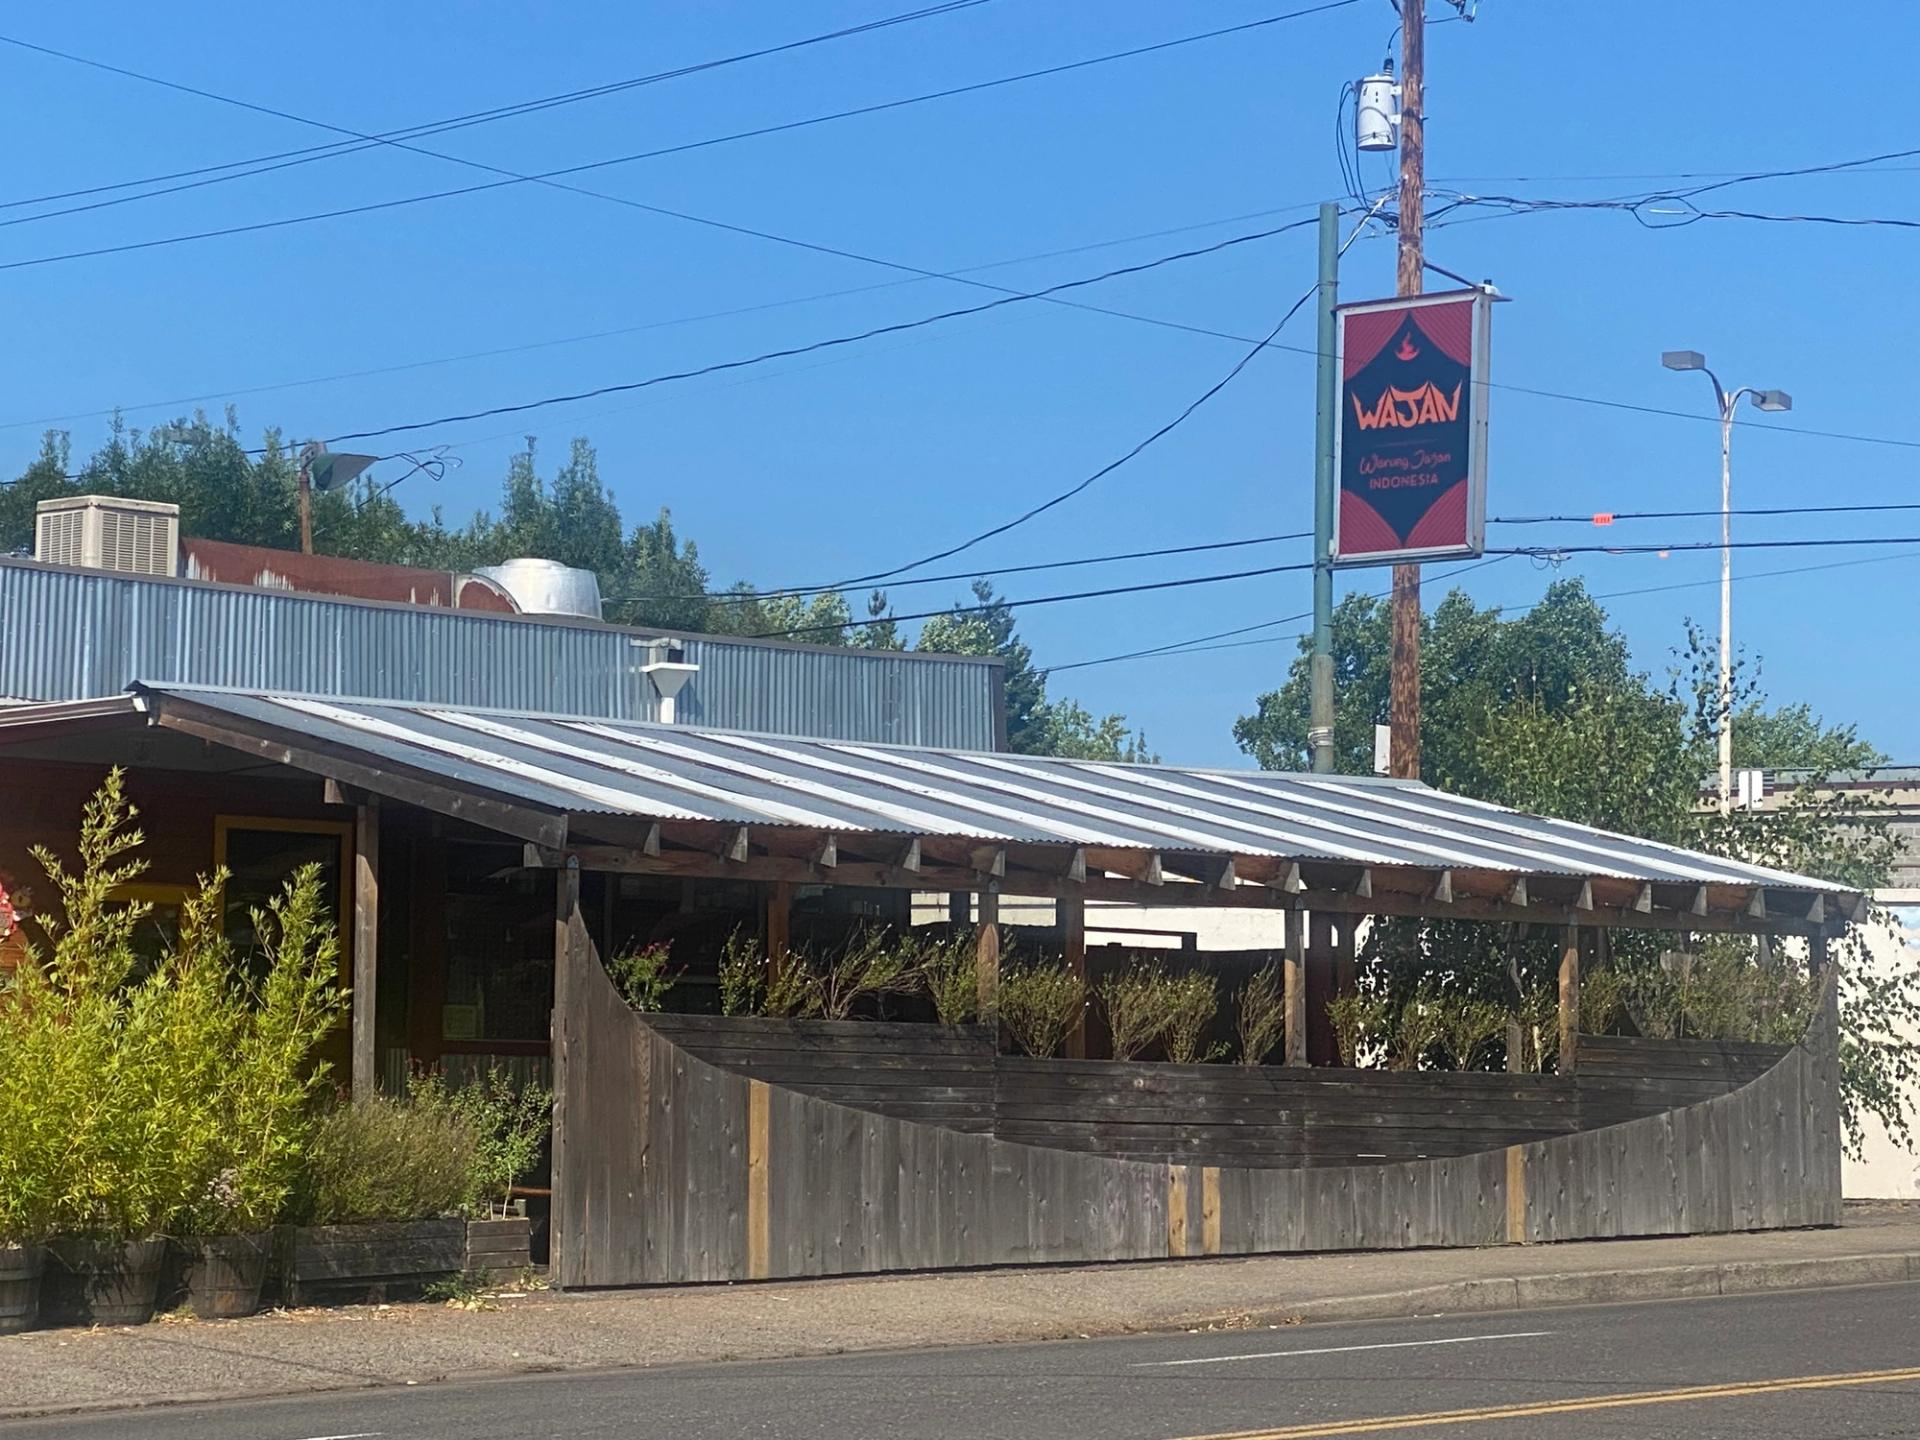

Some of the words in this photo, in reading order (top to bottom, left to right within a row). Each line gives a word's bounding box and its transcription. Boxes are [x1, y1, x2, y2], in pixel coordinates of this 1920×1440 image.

[1351, 380, 1462, 430] WAJAN
[1360, 454, 1409, 474] Warung
[1370, 474, 1438, 489] INDONESIA
